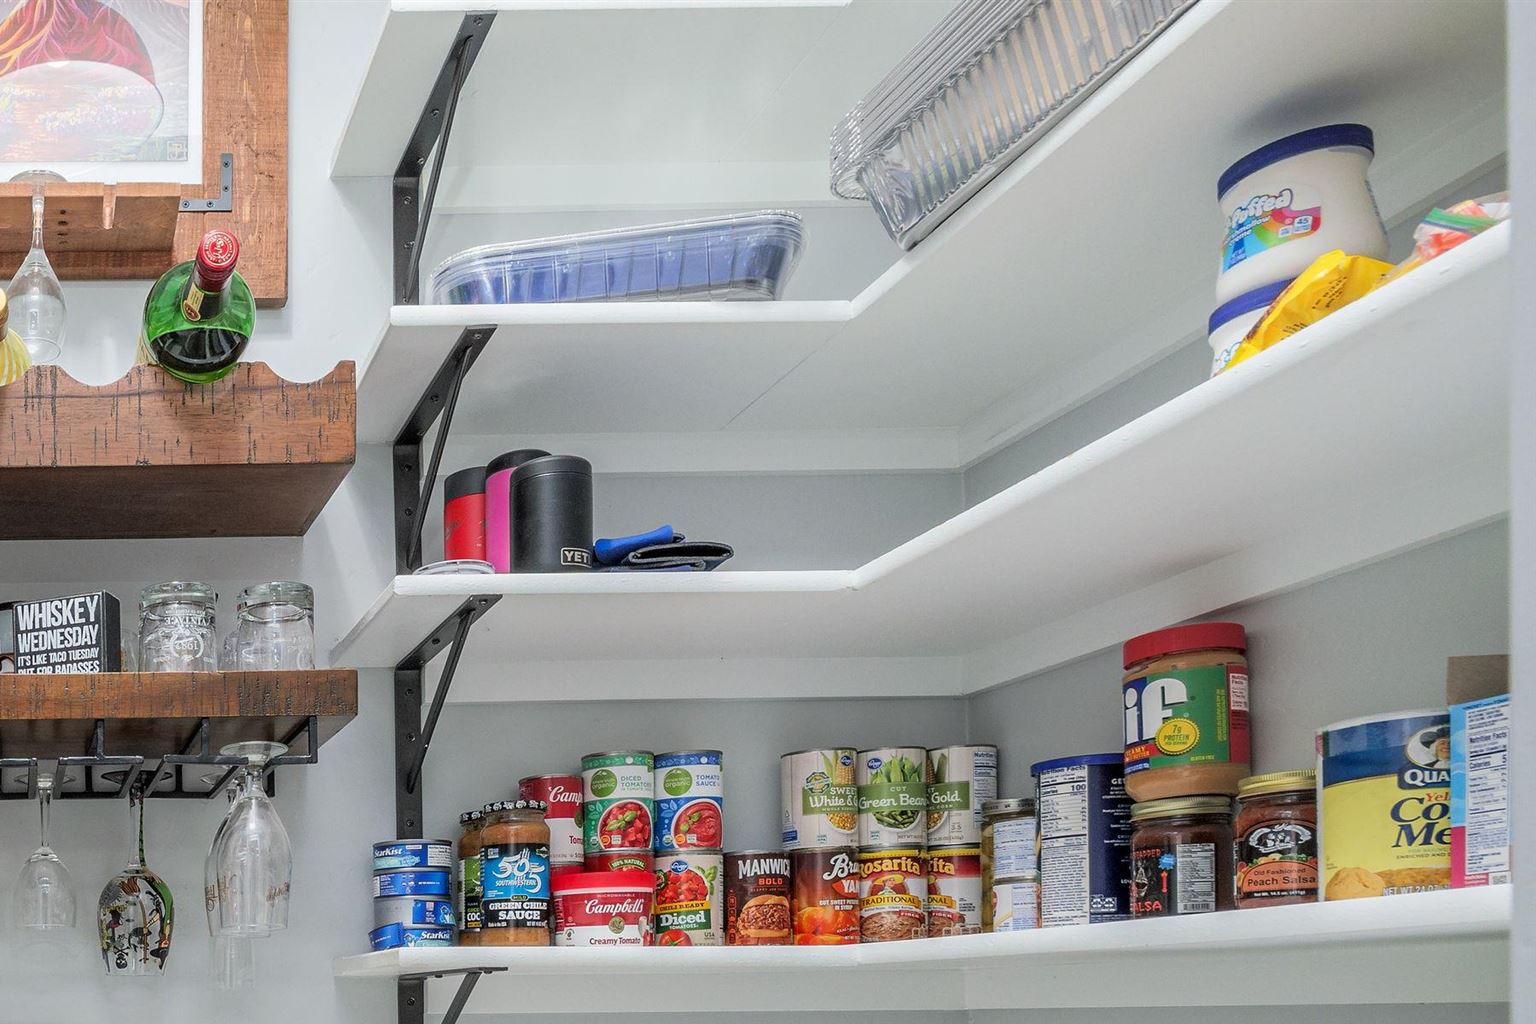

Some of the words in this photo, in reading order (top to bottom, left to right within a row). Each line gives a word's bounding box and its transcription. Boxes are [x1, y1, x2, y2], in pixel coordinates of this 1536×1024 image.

[564, 551, 591, 565] YETI
[17, 595, 99, 631] WHISKEY
[18, 624, 99, 653] WEDNESDAY
[18, 656, 31, 667] IT'S
[32, 653, 47, 665] LIKE
[49, 651, 66, 662] TACO
[69, 647, 100, 660] TUESDAY
[56, 661, 100, 674] BADASSES
[1172, 724, 1182, 733] 7g
[1404, 769, 1450, 786] QUA
[1070, 783, 1086, 792] 100
[809, 794, 846, 808] White
[858, 797, 898, 809] Green
[1390, 797, 1450, 823] Co
[1391, 822, 1451, 848] Me
[374, 847, 403, 858] StarKist
[624, 859, 645, 867] NATURAL
[738, 859, 790, 880] MANWIC
[492, 848, 545, 893] 505
[1247, 877, 1278, 887] Peach
[1282, 876, 1317, 885] Salsa
[489, 902, 522, 910] GREEN
[523, 902, 548, 910] CHILE
[584, 899, 644, 916] Campbell's
[659, 903, 677, 911] CHILI
[678, 902, 705, 910] READY
[498, 910, 541, 920] SAUCE
[660, 911, 706, 926] Diced
[421, 931, 450, 940] StarKist
[589, 937, 617, 946] Creamy
